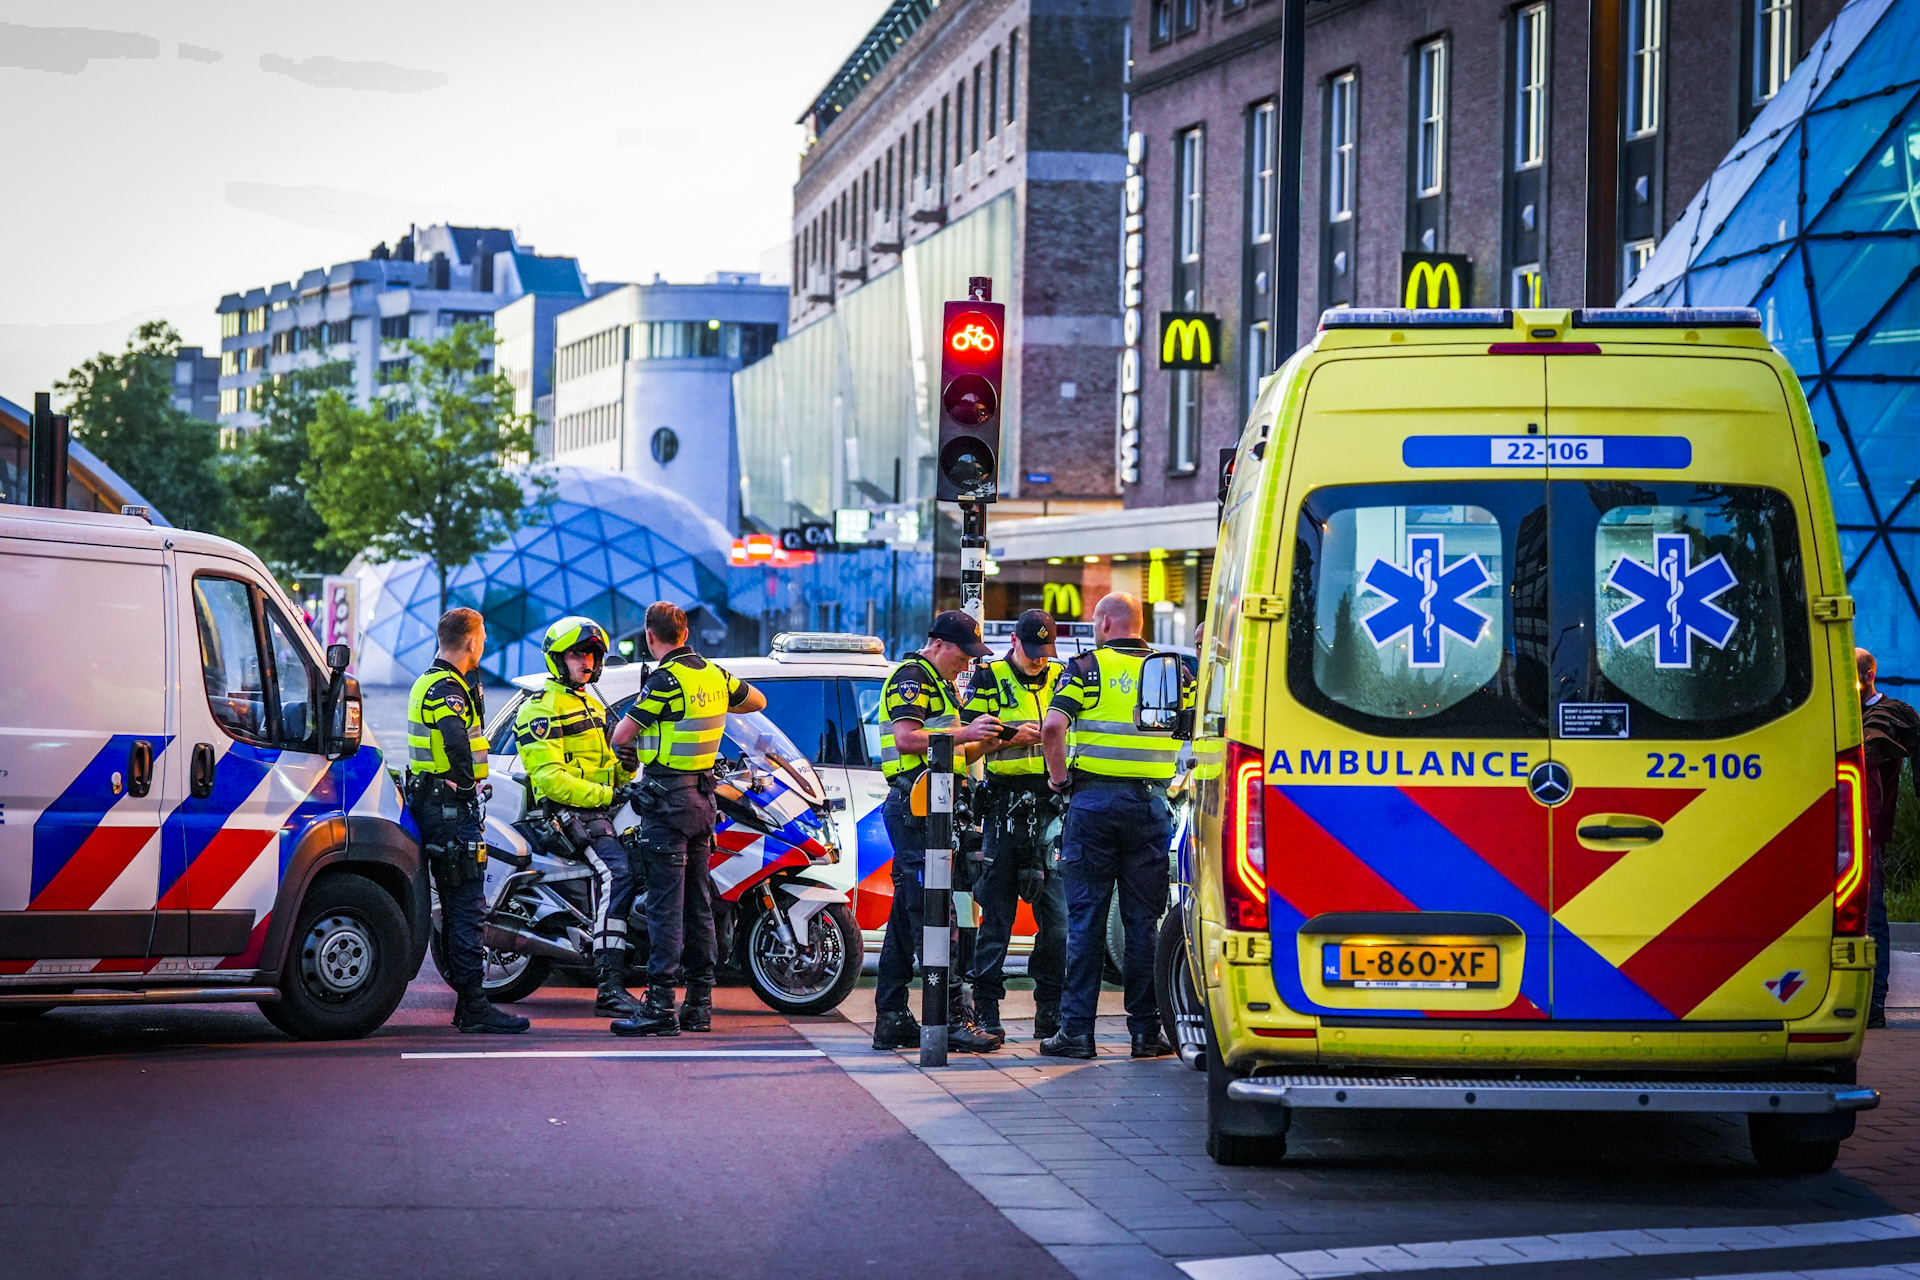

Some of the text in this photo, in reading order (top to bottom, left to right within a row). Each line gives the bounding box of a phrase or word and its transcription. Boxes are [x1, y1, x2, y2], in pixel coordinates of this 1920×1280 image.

[1506, 440, 1589, 462] 22-106
[970, 559, 982, 570] 14
[1269, 750, 1531, 777] AMBULANCE
[1645, 753, 1762, 779] 22-106
[1325, 951, 1485, 977] NL L-860-XF
